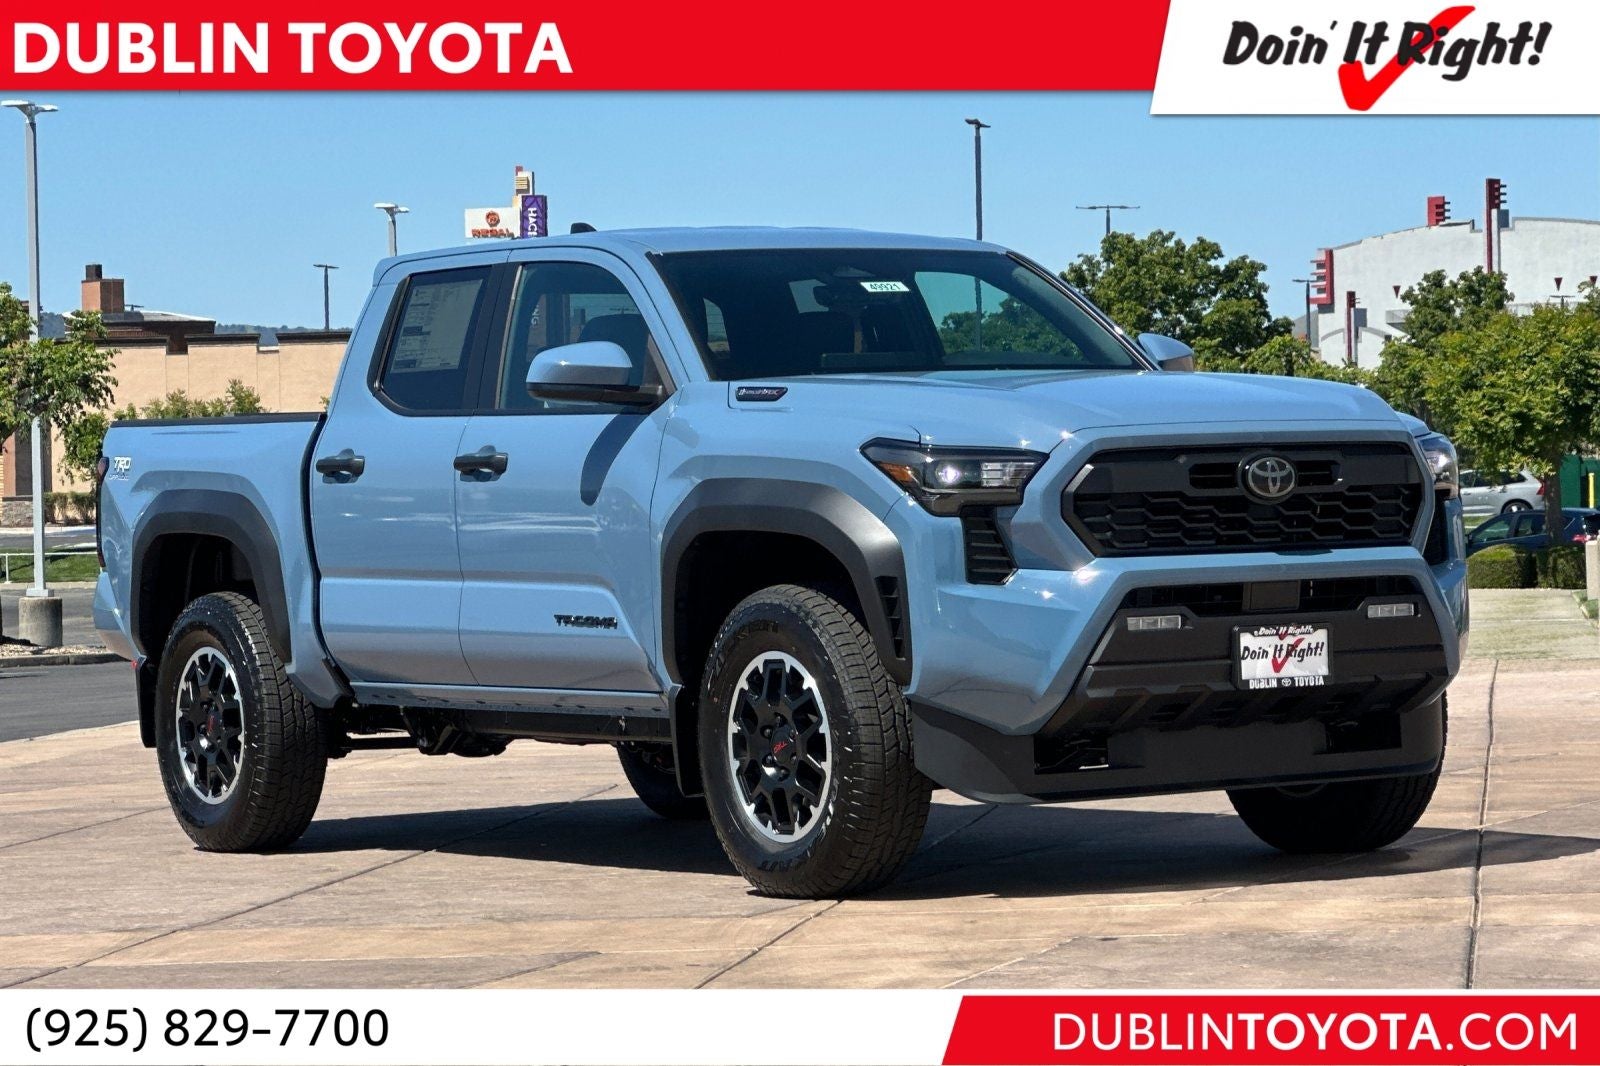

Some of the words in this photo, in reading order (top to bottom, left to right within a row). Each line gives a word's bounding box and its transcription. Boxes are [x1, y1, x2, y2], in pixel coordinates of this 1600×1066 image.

[869, 283, 901, 291] 49921
[114, 456, 131, 472] TRD
[554, 614, 618, 629] TACOMA
[1241, 645, 1271, 661] Doin'
[1273, 644, 1285, 659] It
[1286, 642, 1325, 662] Right!
[1249, 678, 1277, 690] DUBLIN
[1294, 675, 1324, 687] TOYOTA
